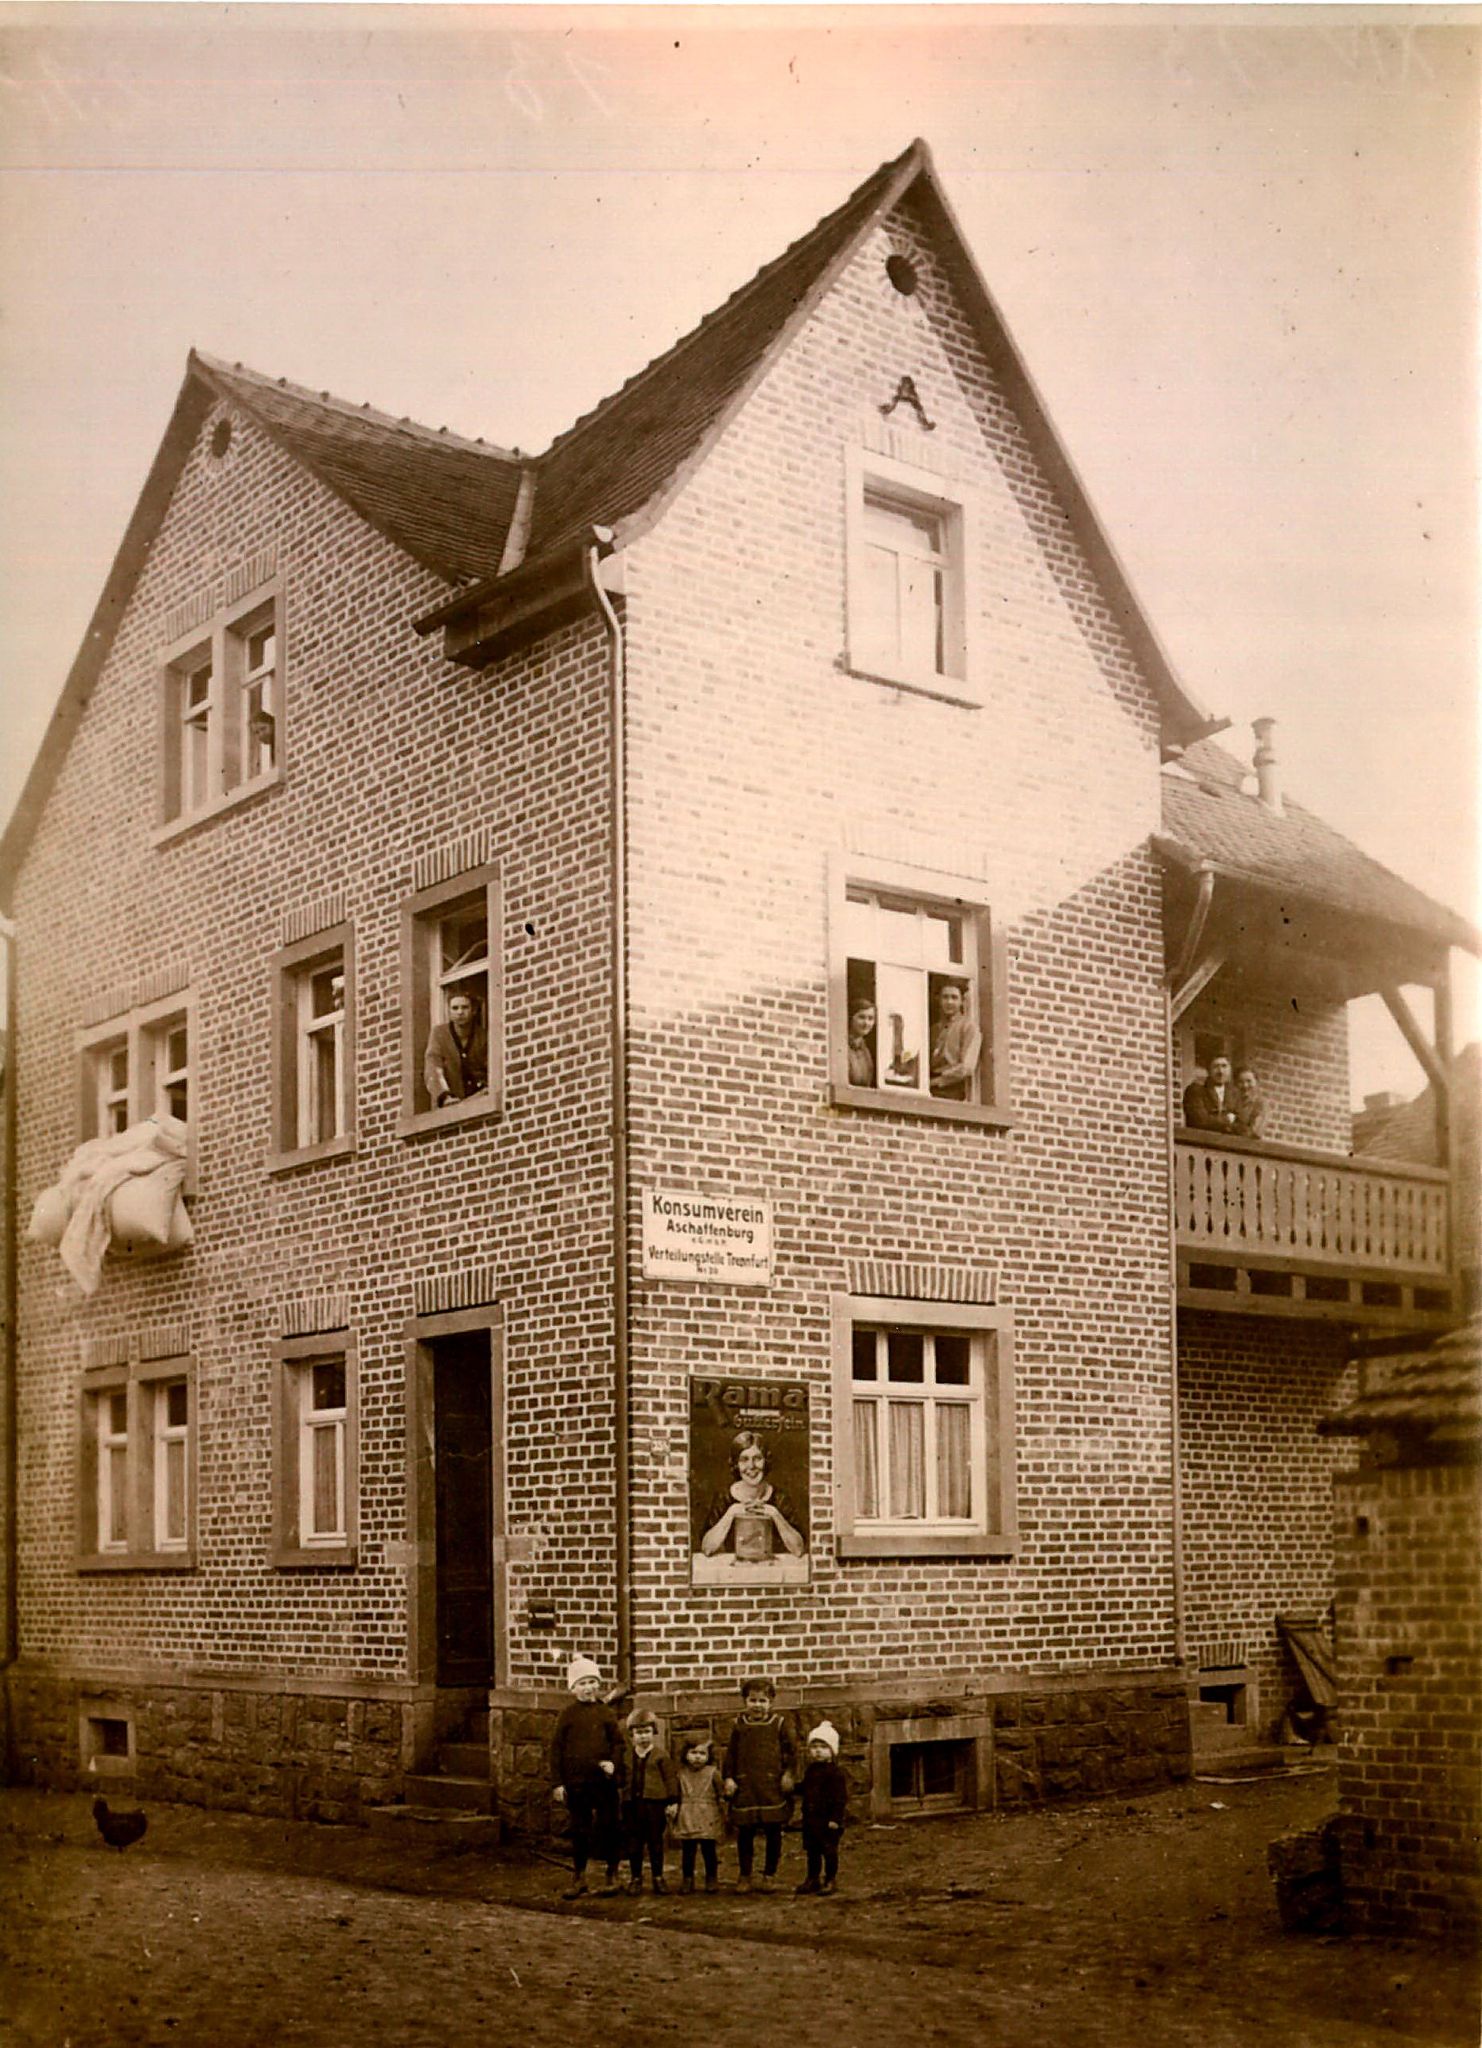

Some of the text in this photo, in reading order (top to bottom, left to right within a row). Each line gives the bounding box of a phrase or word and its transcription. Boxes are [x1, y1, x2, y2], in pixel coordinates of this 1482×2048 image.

[878, 376, 937, 431] A
[652, 1195, 764, 1224] Konsumverein
[691, 1377, 808, 1427] Rama
